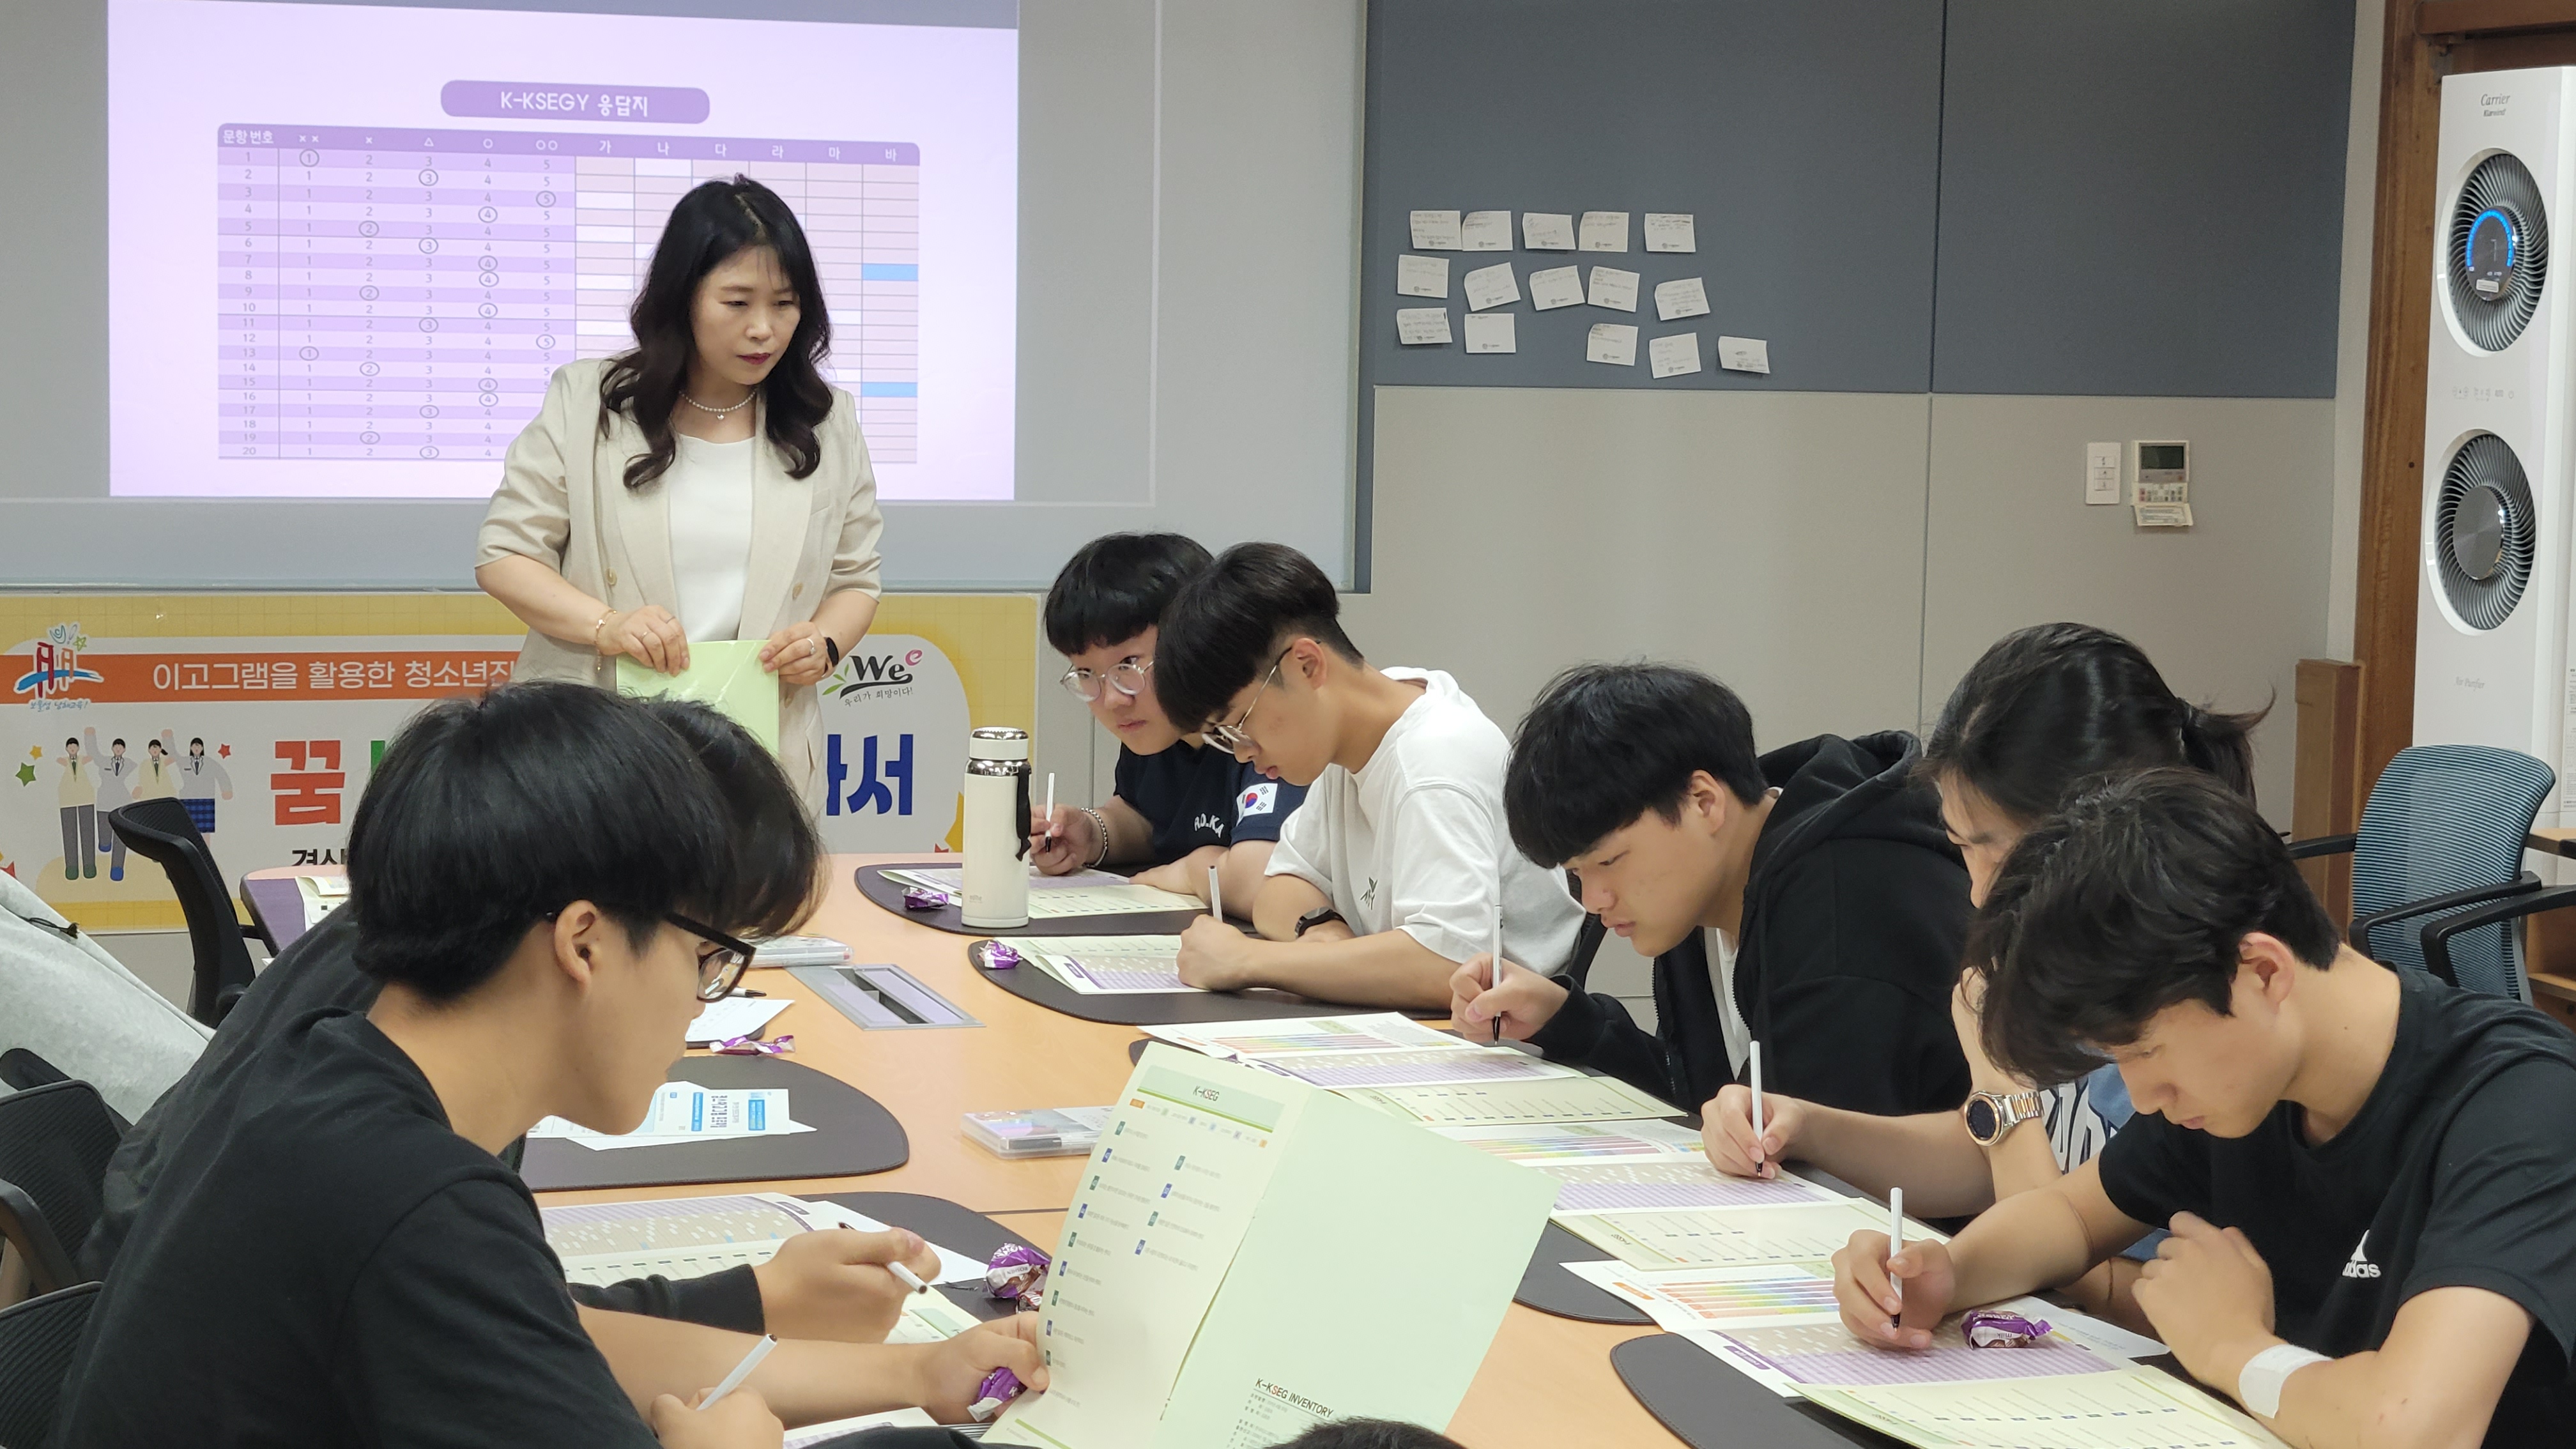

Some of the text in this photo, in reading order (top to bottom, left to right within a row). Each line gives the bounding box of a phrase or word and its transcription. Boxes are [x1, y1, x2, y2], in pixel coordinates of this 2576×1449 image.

[501, 91, 648, 117] K-KSEGY 응답지
[2480, 93, 2510, 106] Carrier
[224, 130, 897, 162] 문항 번호 가 나 다 라 마 바
[366, 155, 372, 165] 2
[426, 157, 432, 166] 3
[485, 158, 491, 167] 4
[544, 160, 550, 169] 5
[245, 169, 251, 179] 2
[366, 172, 372, 181] 2
[485, 175, 491, 184] 4
[544, 176, 550, 187] 5
[245, 187, 251, 197] 3
[366, 190, 372, 199] 2
[426, 191, 432, 201] 3
[485, 193, 491, 202] 4
[245, 204, 251, 213] 4
[366, 206, 372, 216] 2
[427, 208, 432, 217] 3
[544, 211, 550, 220] 5
[245, 221, 251, 231] 5
[426, 225, 432, 234] 3
[485, 227, 491, 235] 4
[544, 228, 549, 237] 5
[245, 238, 252, 247] 6
[366, 240, 372, 249] 2
[485, 243, 491, 251] 4
[544, 244, 550, 253] 5
[246, 254, 252, 264] 7
[366, 257, 372, 266] 2
[426, 258, 432, 267] 3
[544, 261, 550, 270] 5
[245, 271, 252, 279] 8
[366, 273, 372, 282] 2
[426, 274, 432, 282] 3
[544, 276, 549, 285] 5
[245, 287, 252, 296] 9
[426, 289, 432, 299] 3
[485, 291, 491, 299] 4
[544, 292, 550, 301] 5
[243, 303, 256, 311] 10
[366, 305, 372, 313] 2
[427, 306, 432, 314] 3
[544, 308, 549, 316] 5
[243, 318, 255, 326] 11
[366, 320, 372, 329] 2
[485, 321, 491, 330] 4
[544, 323, 550, 332] 5
[243, 334, 256, 342] 12
[367, 335, 372, 344] 2
[426, 336, 432, 345] 3
[485, 337, 491, 345] 4
[243, 348, 256, 357] 13
[366, 349, 372, 358] 2
[426, 351, 433, 360] 3
[485, 351, 491, 360] 4
[544, 353, 550, 361] 5
[243, 363, 256, 371] 14
[426, 365, 432, 374] 3
[485, 366, 491, 374] 4
[544, 367, 549, 375] 5
[243, 378, 256, 386] 15
[366, 379, 372, 387] 2
[426, 379, 433, 388] 3
[367, 394, 372, 402] 2
[427, 394, 432, 402] 3
[244, 406, 256, 414] 17
[367, 407, 372, 415] 2
[426, 422, 432, 430] 3
[427, 434, 432, 443] 3
[243, 447, 256, 455] 20
[153, 661, 298, 691] 이고그램을
[309, 661, 395, 689] 활용한
[845, 687, 914, 707] 우리가 희망이다!
[270, 740, 346, 825] 꿈
[1193, 1085, 1220, 1102] K-KSEG
[1255, 1377, 1335, 1418] K-KSEG INVENTORY
